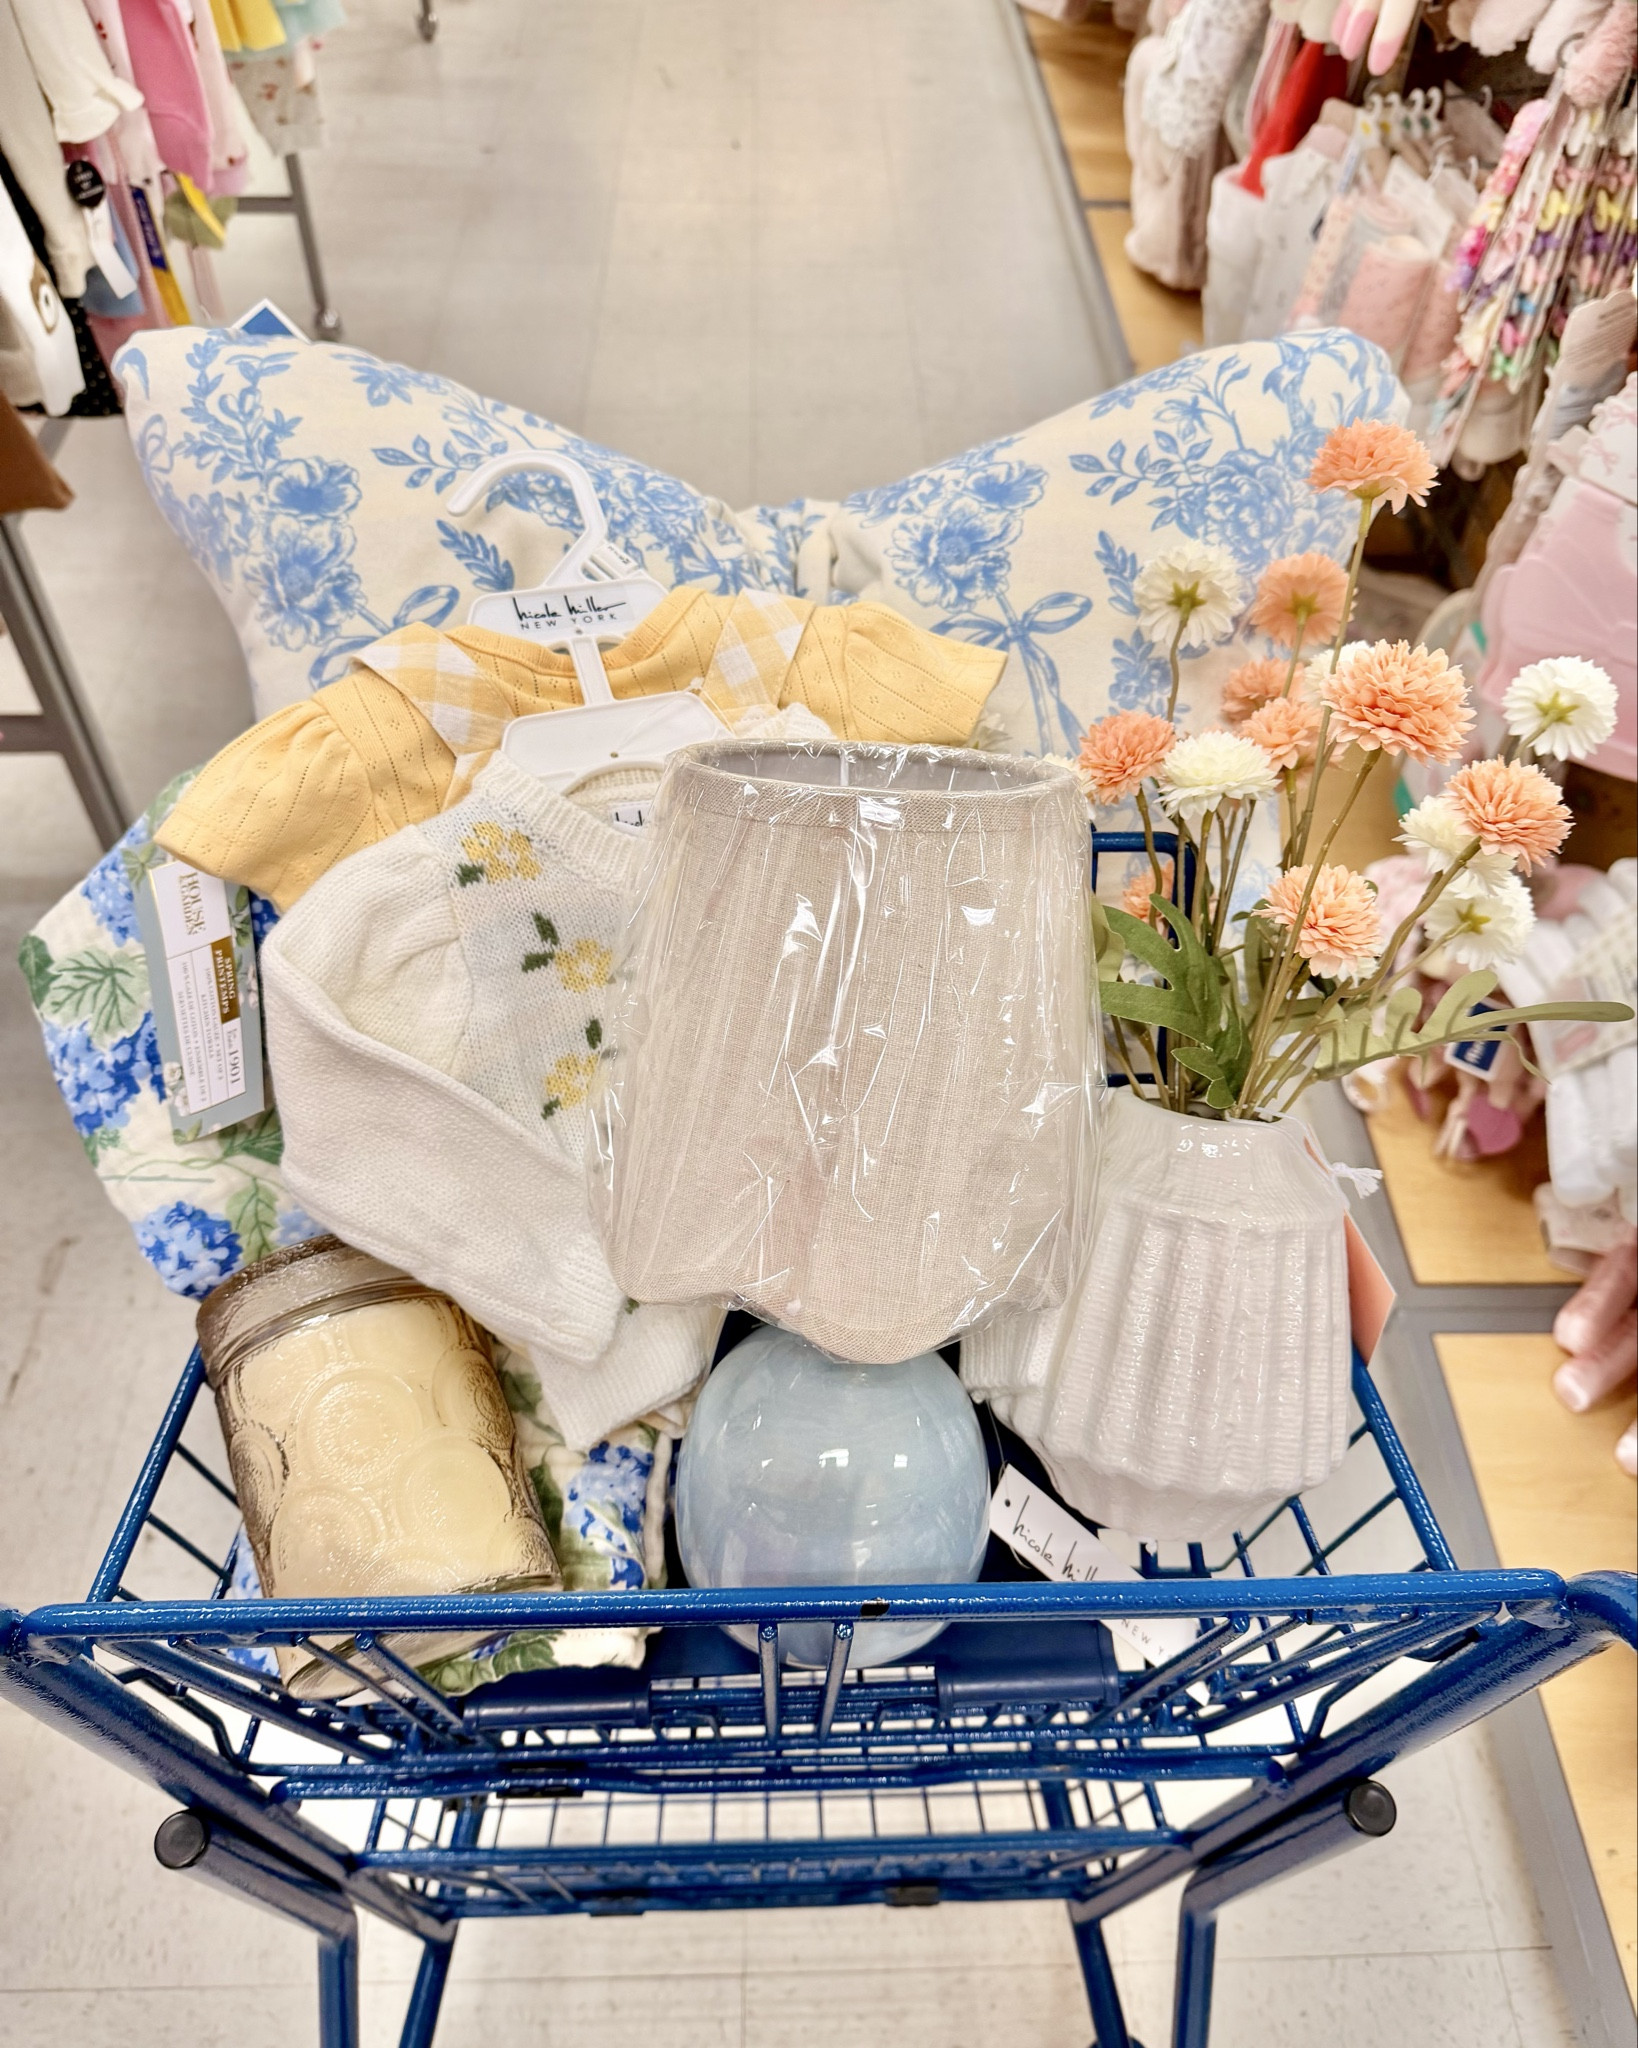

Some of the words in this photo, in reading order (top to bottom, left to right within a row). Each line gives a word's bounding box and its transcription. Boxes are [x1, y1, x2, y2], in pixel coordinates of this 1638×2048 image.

[520, 619, 557, 631] NEW
[571, 613, 617, 624] YORK
[186, 871, 207, 933] HOUSE
[214, 949, 230, 1015] PRINTEMPS
[224, 956, 237, 1000] SPRING
[227, 1049, 241, 1084] 1901
